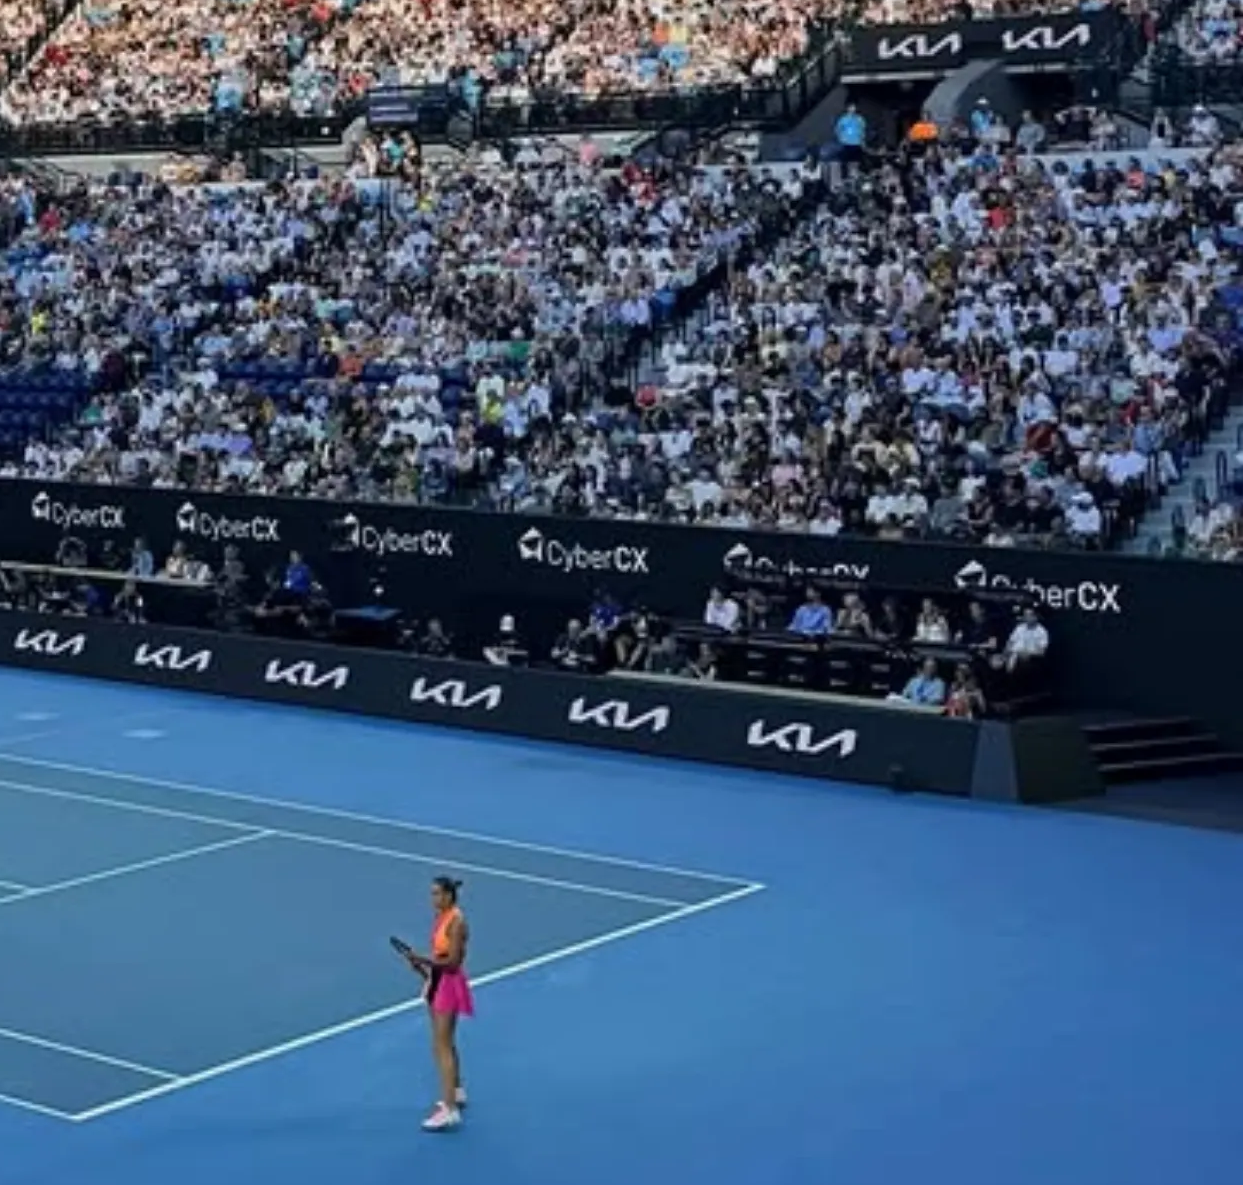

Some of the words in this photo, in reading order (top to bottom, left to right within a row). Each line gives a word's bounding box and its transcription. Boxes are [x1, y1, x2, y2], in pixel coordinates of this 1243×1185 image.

[878, 32, 961, 59] KIA
[1001, 23, 1091, 51] KIA
[51, 505, 125, 530] CyberCX
[200, 515, 280, 541] CyberCX
[361, 526, 453, 557] CyberCX
[547, 541, 649, 573] CyberCX
[991, 574, 1121, 614] berCX
[14, 628, 87, 656] KIA
[134, 643, 212, 672] KIA
[264, 659, 349, 690] KIA
[410, 677, 502, 710] KIA
[568, 698, 670, 732] KIA
[747, 719, 857, 757] KIA
